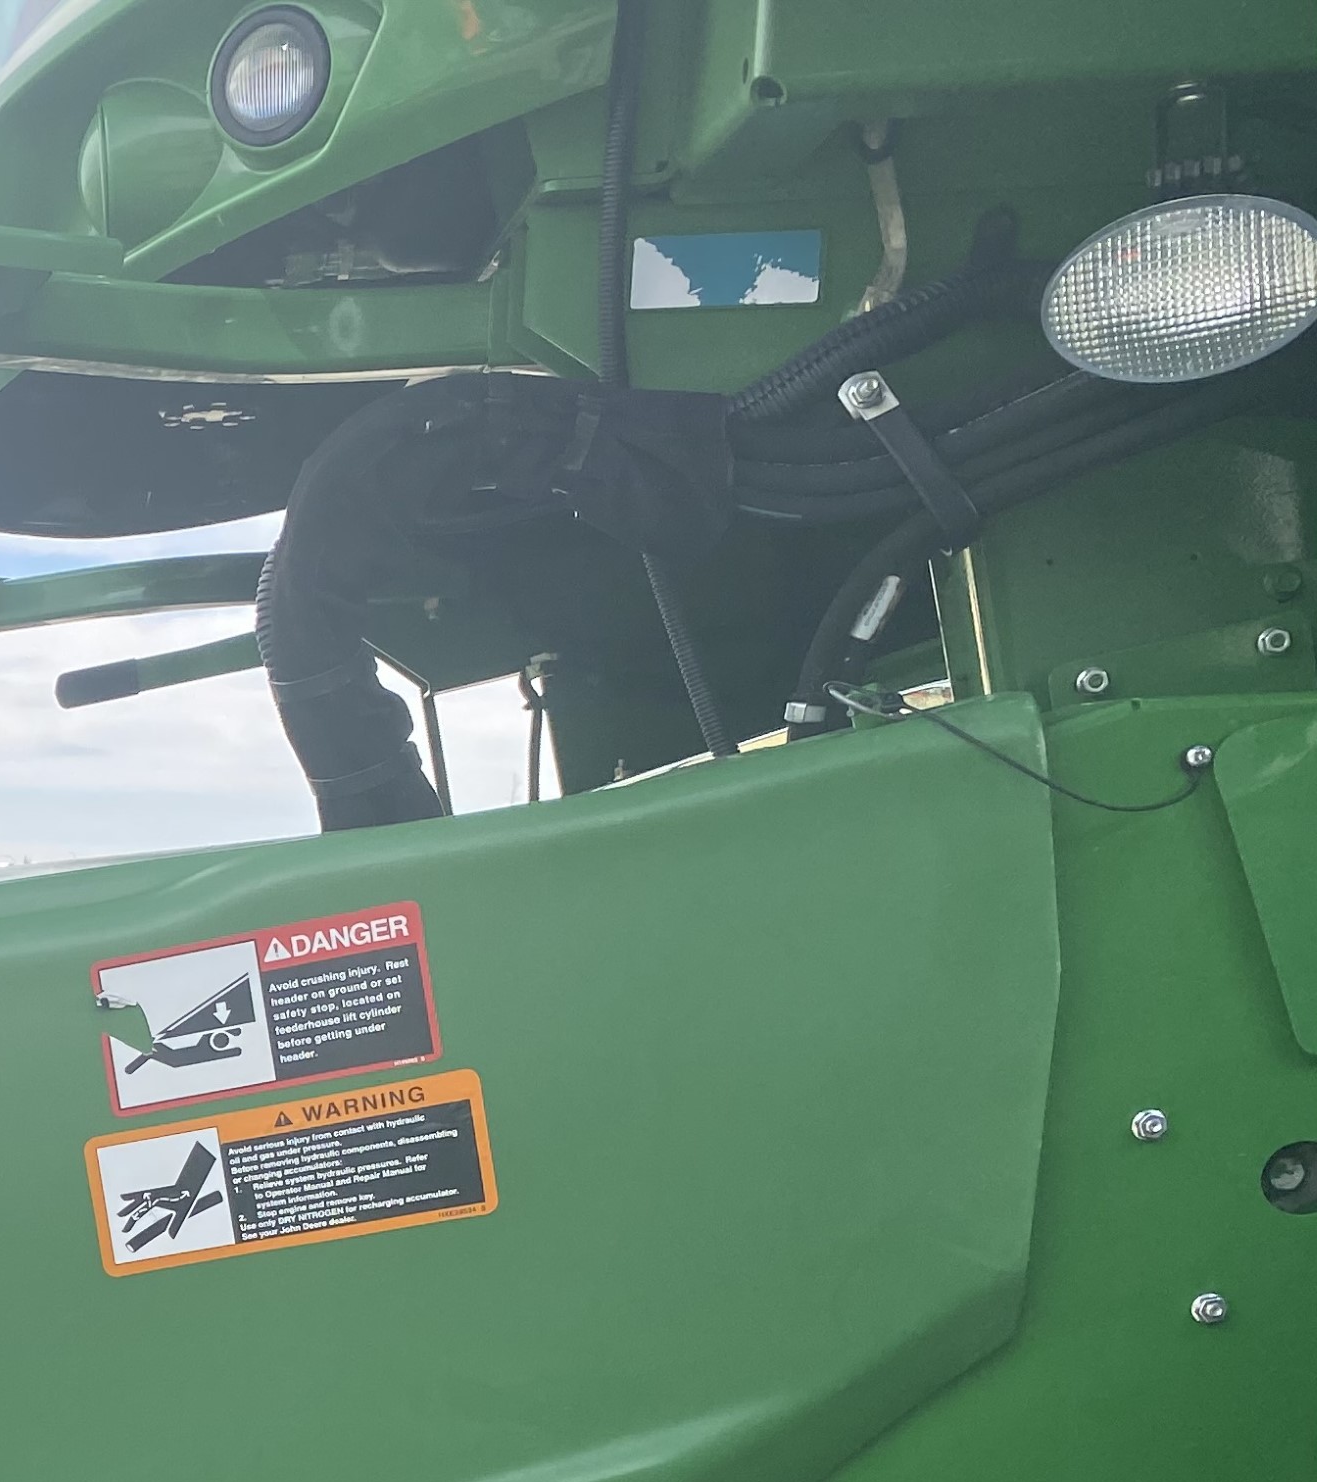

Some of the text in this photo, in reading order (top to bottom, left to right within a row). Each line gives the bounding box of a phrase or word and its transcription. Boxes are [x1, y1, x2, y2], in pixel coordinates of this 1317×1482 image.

[290, 914, 409, 957] DANGER
[269, 958, 409, 992] Avoid crushing injury. Rest
[271, 975, 402, 1006] header on ground or set
[273, 991, 400, 1020] safety stop, located on
[275, 1006, 401, 1035] feederhouse lift cylinder
[277, 1023, 385, 1049] before getting under
[280, 1051, 318, 1063] header.
[302, 1086, 425, 1121] WARNING
[228, 1115, 425, 1155] Avoid serious injury from contact with hydraulic
[231, 1130, 458, 1174] Before removing hydraulic components, disassembling
[242, 1154, 258, 1162] and
[259, 1152, 274, 1161] gas
[277, 1148, 300, 1156] under
[303, 1141, 342, 1154] pressure.
[244, 1170, 282, 1182] changing
[253, 1180, 283, 1190] Relieve
[285, 1175, 315, 1185] system
[357, 1160, 401, 1173] pressures.
[405, 1154, 428, 1163] Refer
[265, 1187, 301, 1198] Operator
[304, 1180, 333, 1191] Manual
[336, 1177, 351, 1186] and
[353, 1172, 380, 1182] Repair
[382, 1166, 412, 1177] Manual
[240, 1223, 256, 1231] Use
[258, 1219, 276, 1227] only
[278, 1215, 296, 1224] DRY
[298, 1207, 344, 1221] NITROGEN
[359, 1198, 404, 1210] recharging
[406, 1189, 459, 1202] accumulator.
[256, 1191, 338, 1209] system information.
[257, 1210, 277, 1218] Stop
[279, 1205, 307, 1214] engine
[309, 1201, 324, 1209] and
[326, 1197, 357, 1206] remove
[259, 1229, 278, 1239] your
[280, 1225, 301, 1234] John
[303, 1221, 327, 1230] Deere
[329, 1216, 356, 1225] dealer.
